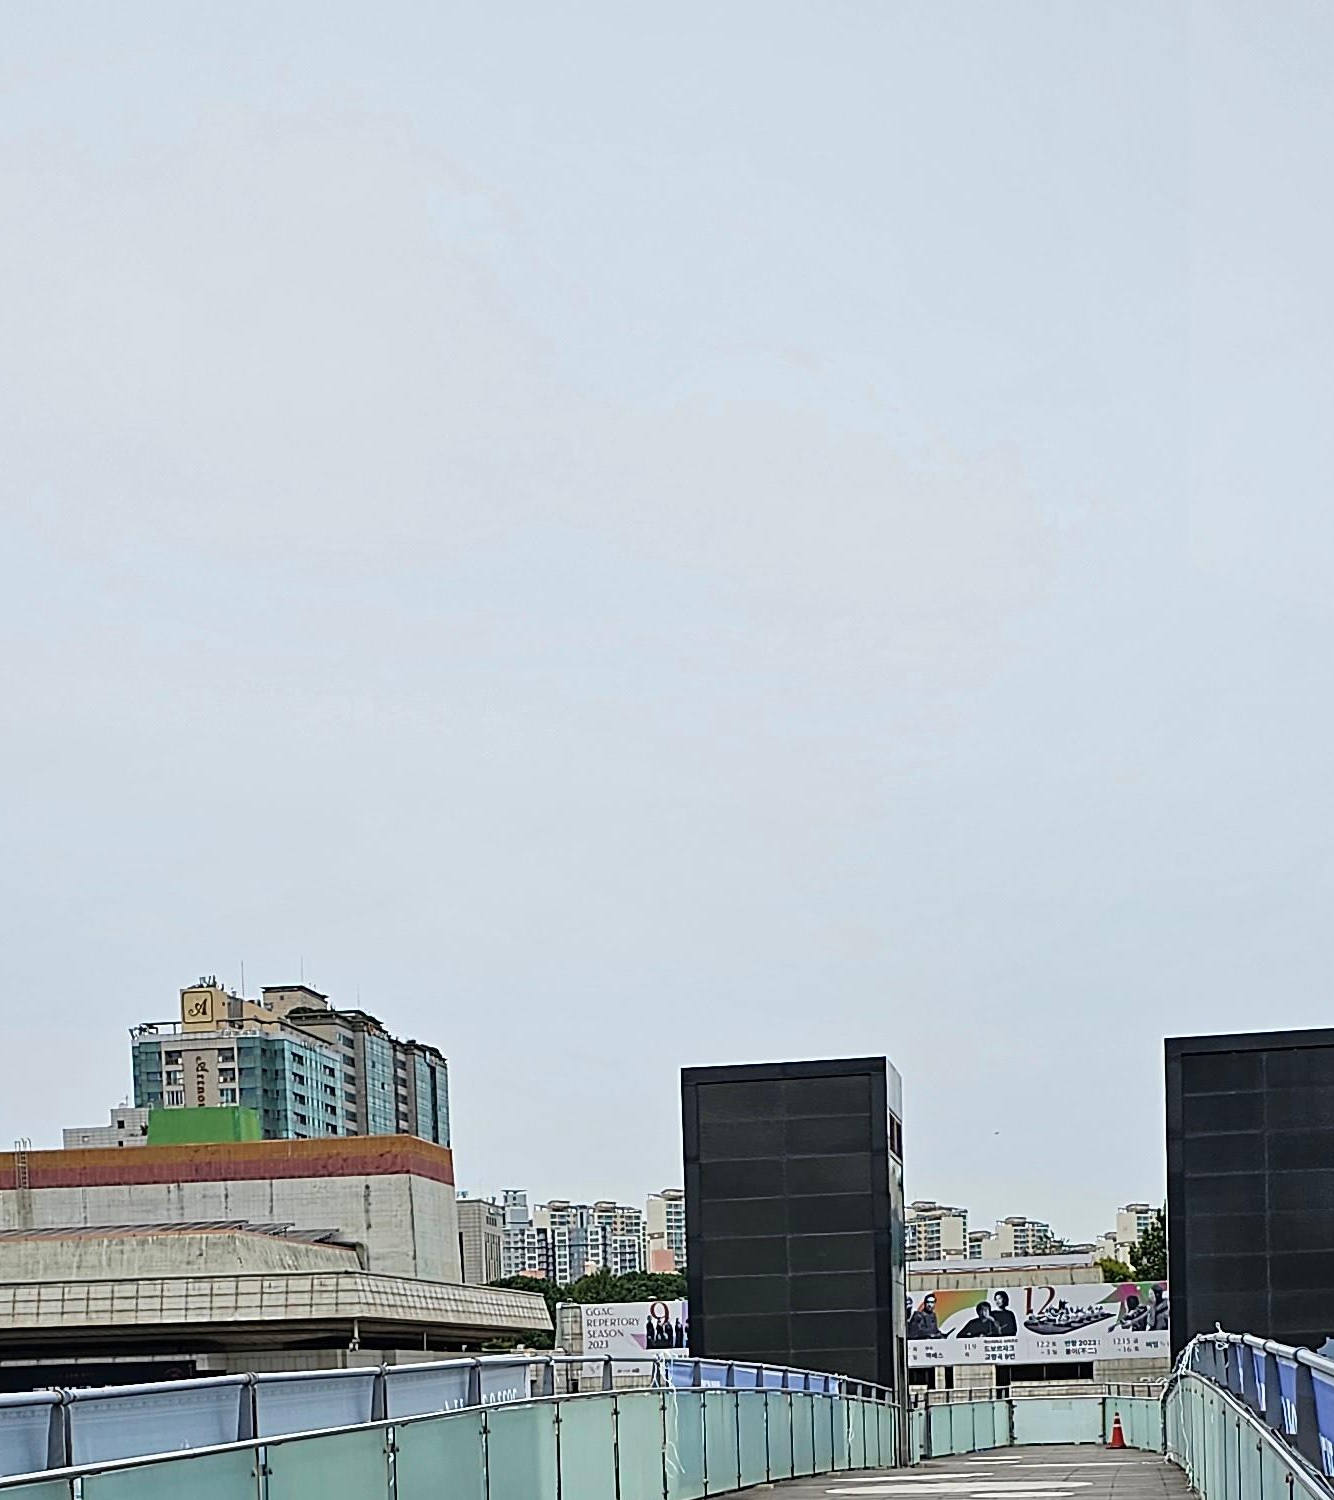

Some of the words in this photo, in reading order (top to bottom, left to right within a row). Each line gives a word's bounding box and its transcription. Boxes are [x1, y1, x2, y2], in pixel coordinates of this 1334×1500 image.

[1023, 1286, 1056, 1316] 12
[585, 1307, 615, 1317] GGAC
[649, 1301, 670, 1327] 9
[586, 1317, 640, 1328] REPERTORY
[587, 1329, 625, 1339] SEASON
[587, 1339, 609, 1350] 2023
